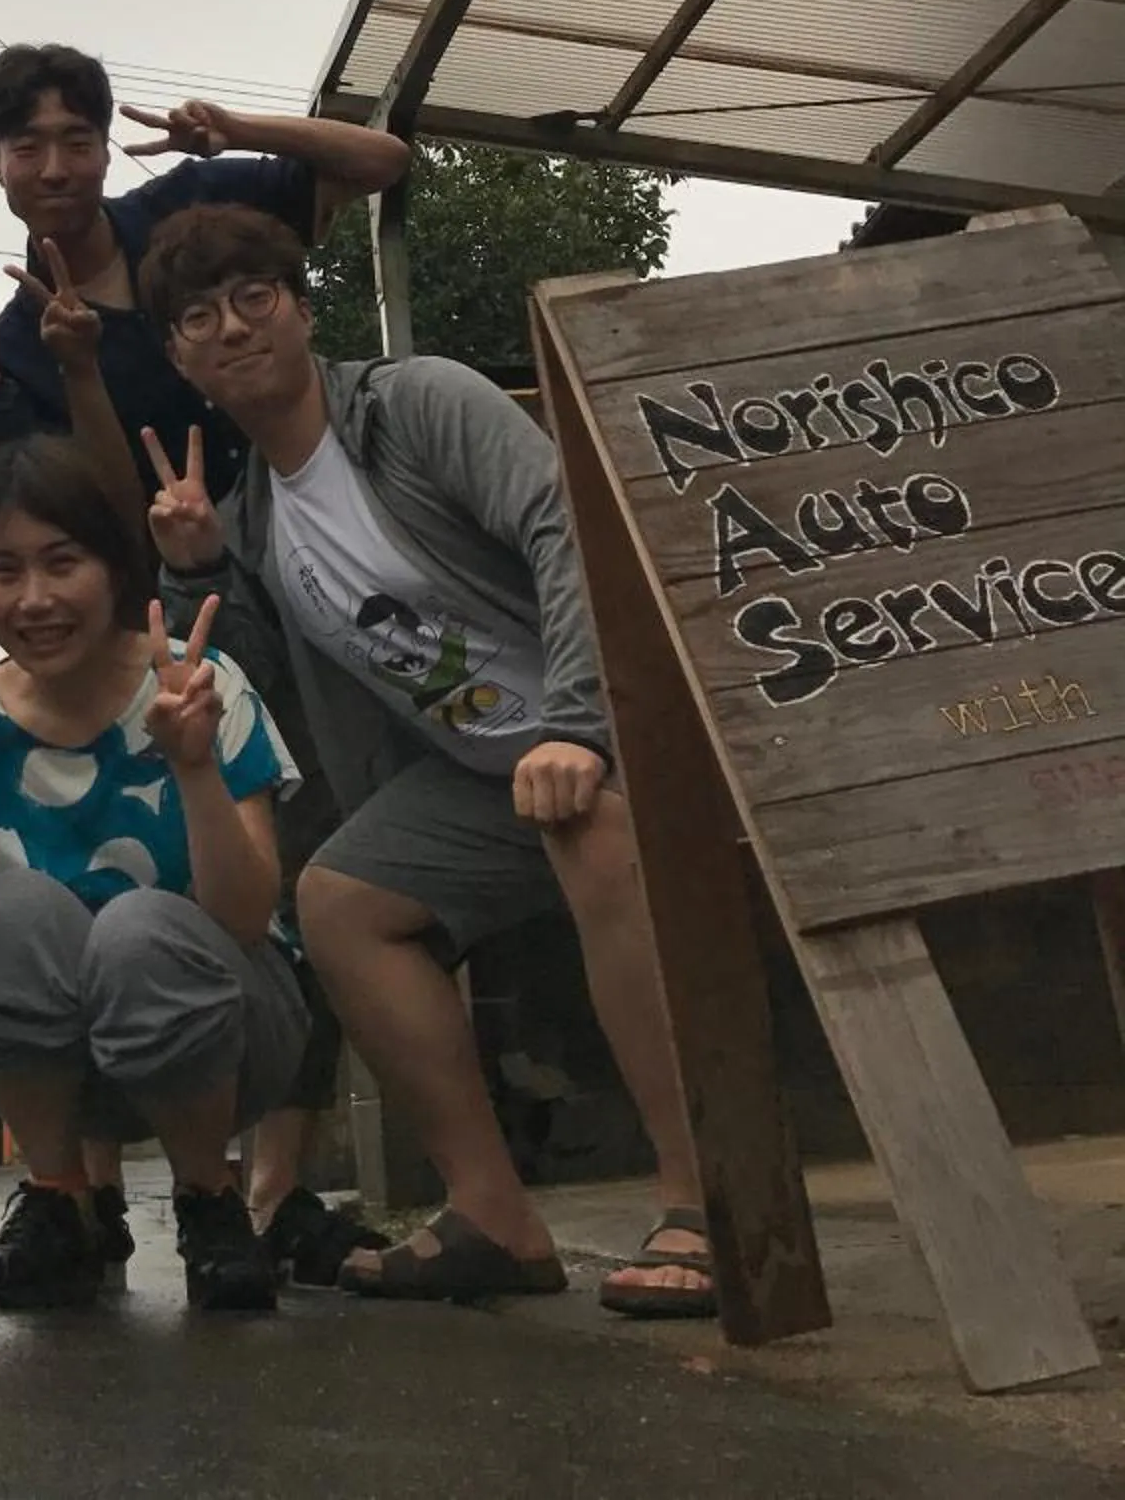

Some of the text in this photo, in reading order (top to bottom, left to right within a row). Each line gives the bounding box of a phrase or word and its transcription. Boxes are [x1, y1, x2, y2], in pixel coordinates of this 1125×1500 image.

[635, 353, 1061, 495] Norishico
[705, 473, 972, 598] Auto
[733, 550, 1125, 709] Service
[939, 675, 1098, 736] with
